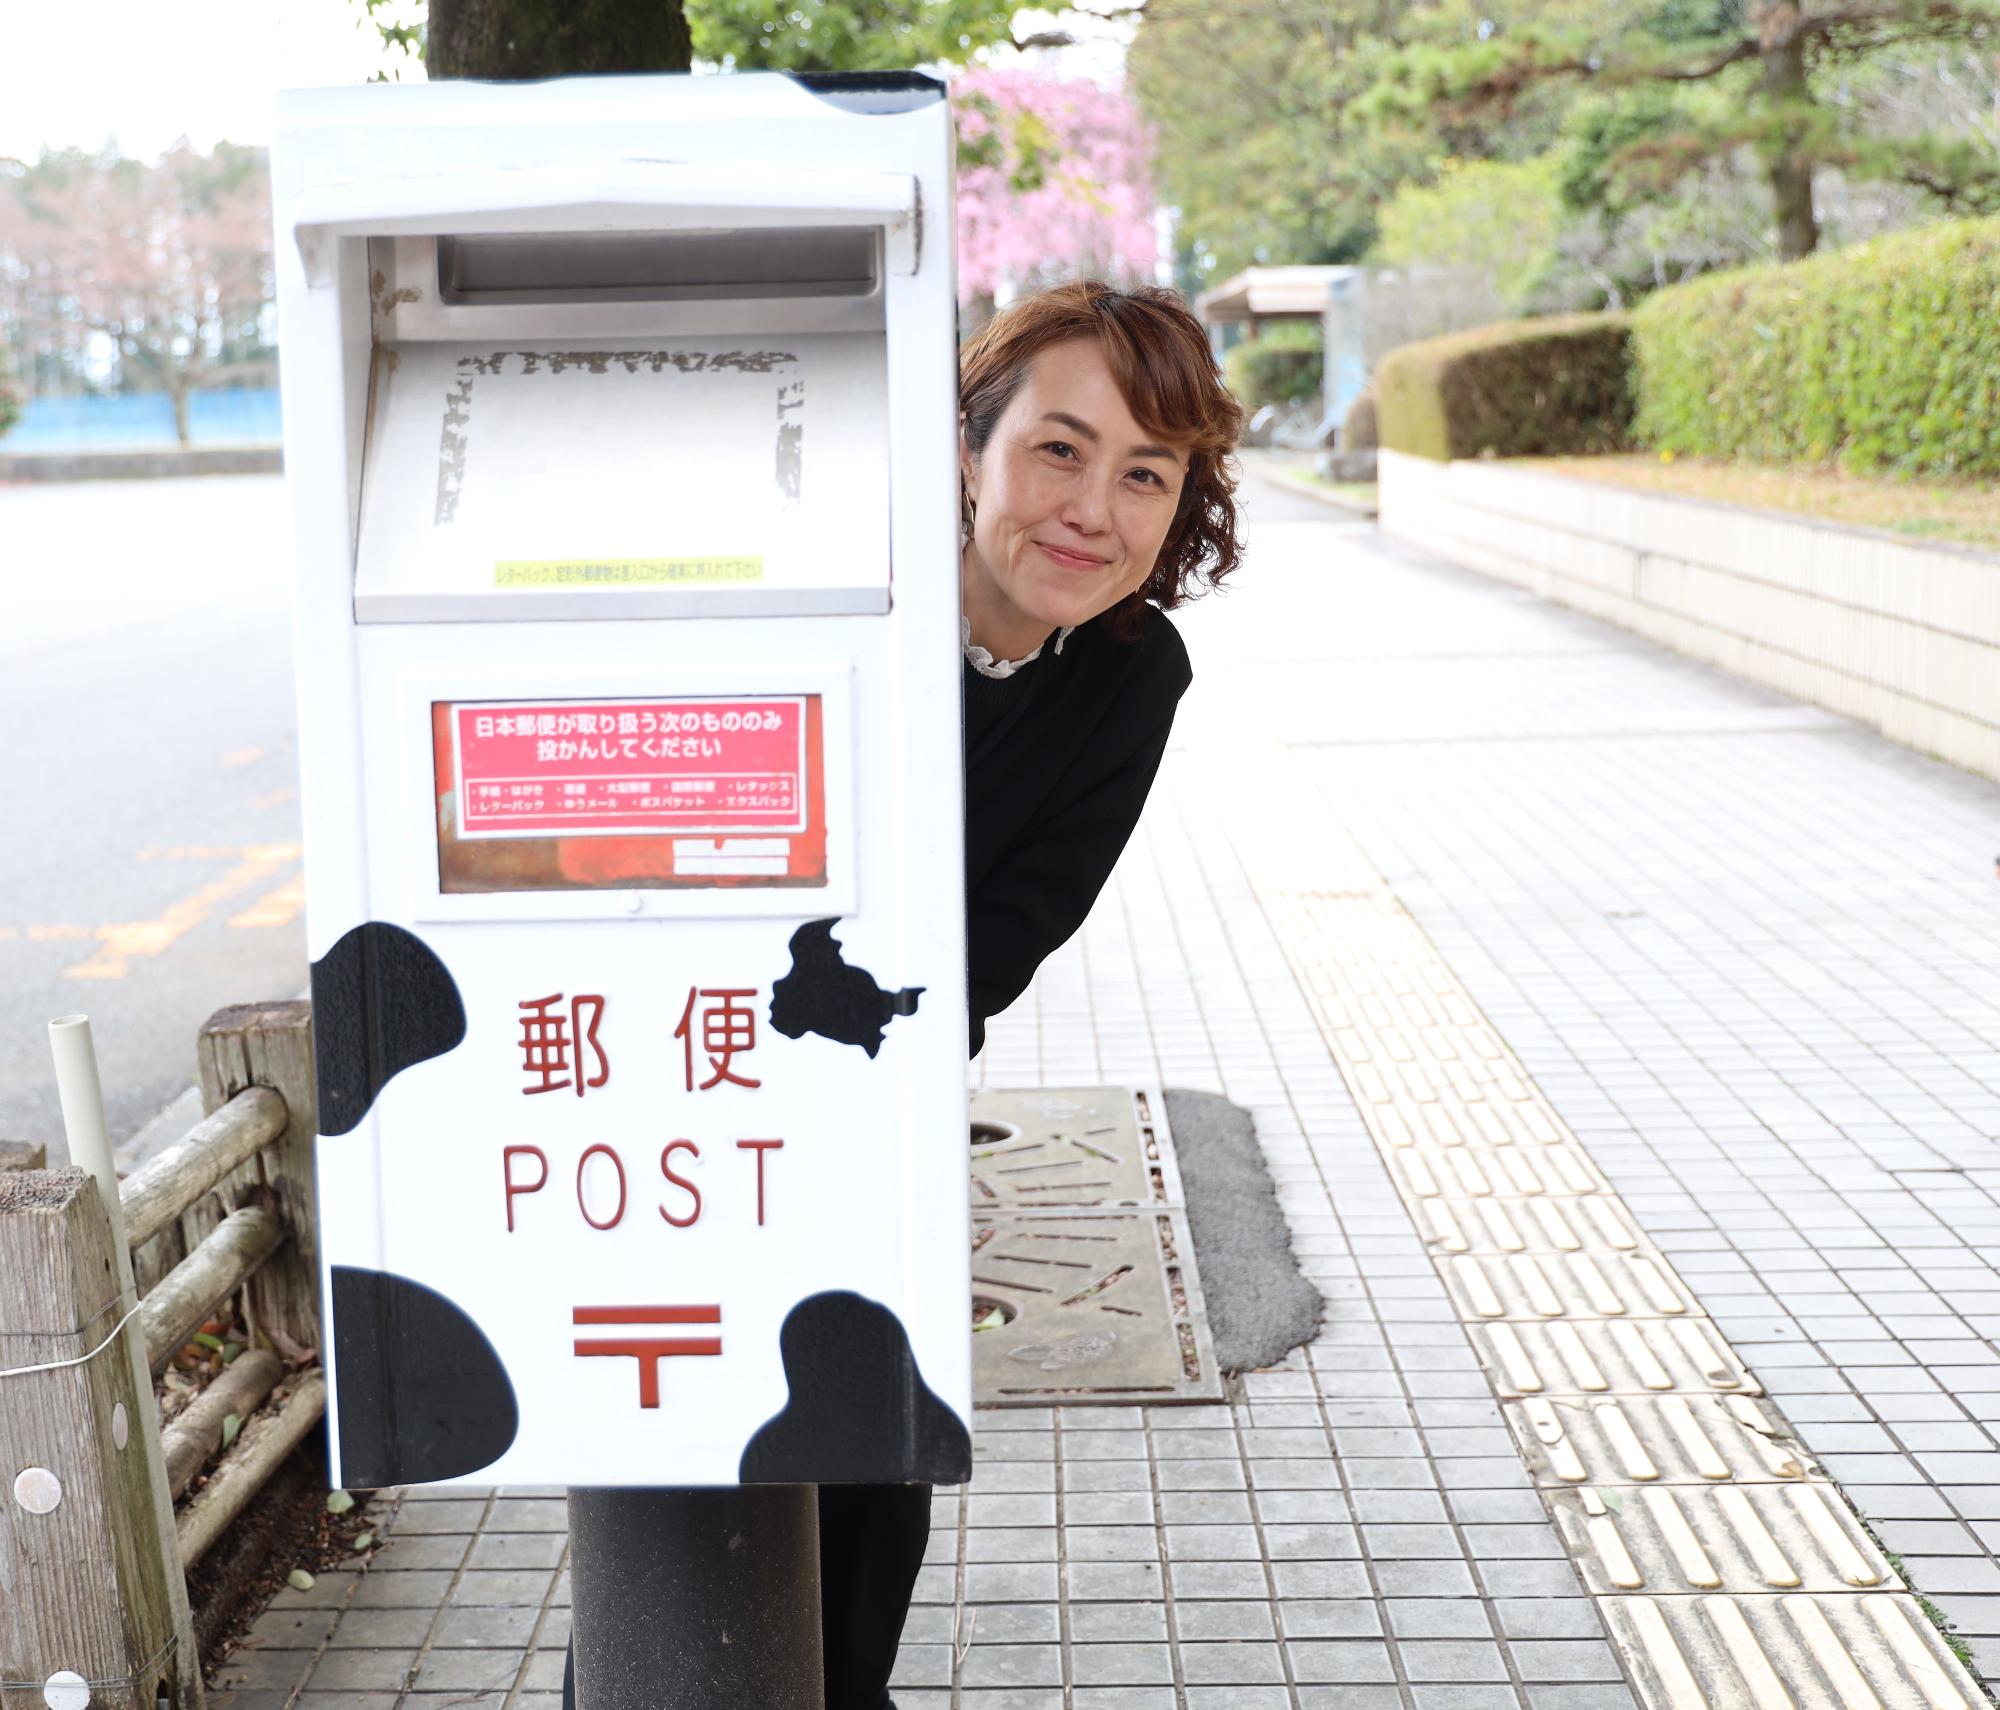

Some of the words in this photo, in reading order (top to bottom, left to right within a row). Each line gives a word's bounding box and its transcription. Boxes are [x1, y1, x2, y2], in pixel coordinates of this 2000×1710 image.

[475, 711, 782, 738] 日本郵便が取り扱う次のもののみ
[536, 738, 722, 762] 投かんしてください
[517, 985, 762, 1098] 郵便
[503, 1137, 785, 1233] POST
